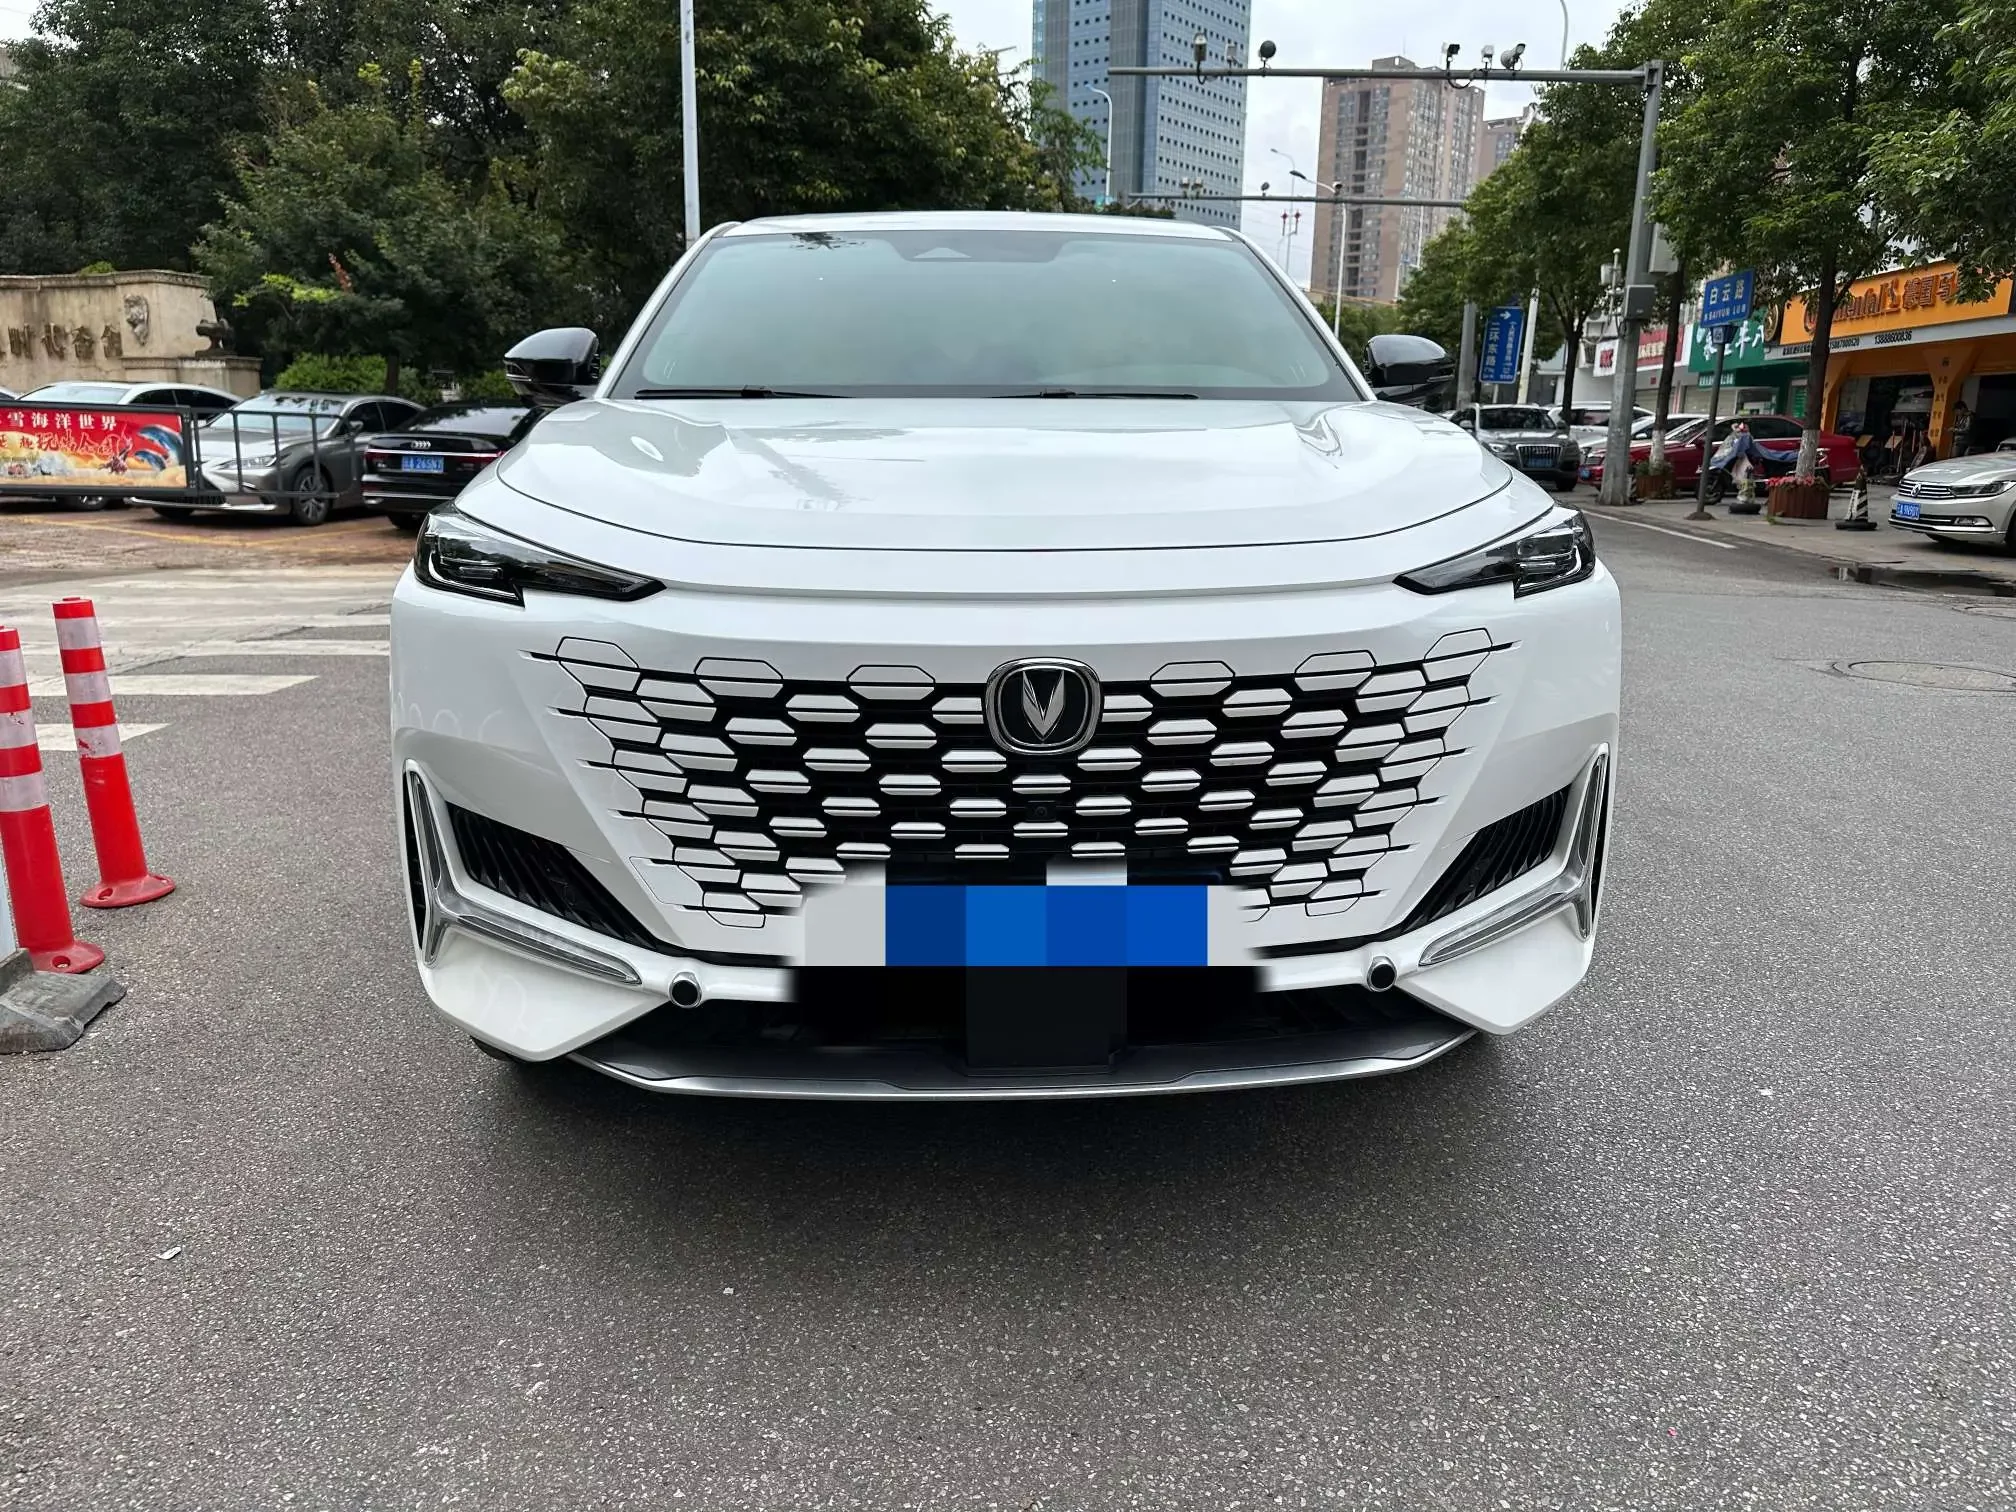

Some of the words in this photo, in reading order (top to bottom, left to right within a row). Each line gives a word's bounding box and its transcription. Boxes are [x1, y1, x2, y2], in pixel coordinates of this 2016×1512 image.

[1710, 280, 1744, 304] 白云路
[1709, 307, 1730, 320] BAIYUN
[0, 412, 117, 430] 雪海洋世界
